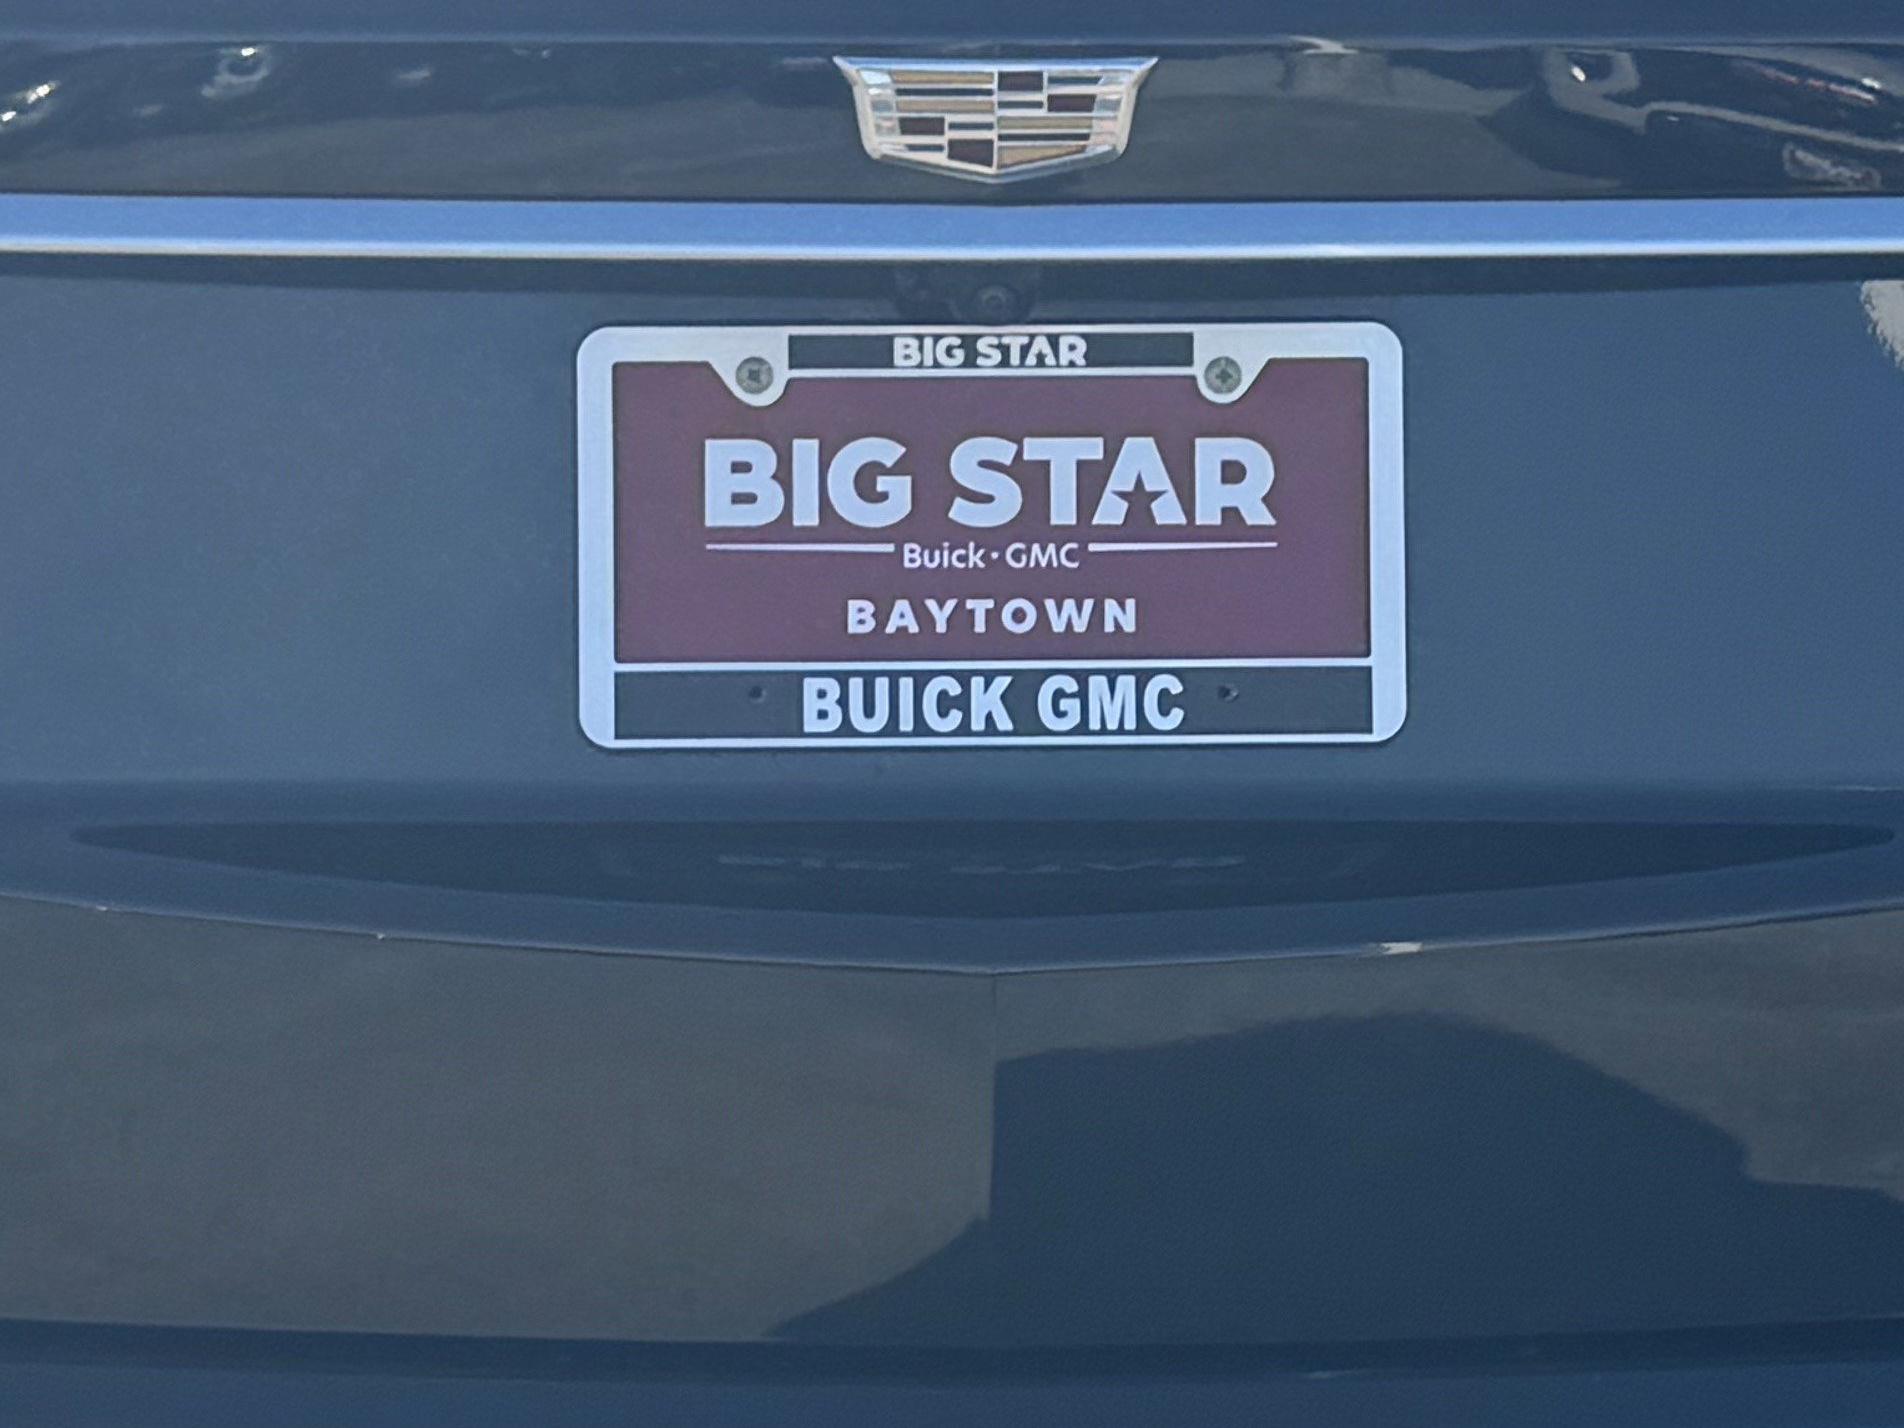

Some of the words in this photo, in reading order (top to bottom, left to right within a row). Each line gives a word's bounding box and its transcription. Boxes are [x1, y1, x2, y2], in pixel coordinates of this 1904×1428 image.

[893, 336, 964, 368] BIG
[976, 335, 1087, 368] STAR
[704, 436, 912, 528] BIG
[947, 436, 1277, 528] STAR
[846, 597, 1137, 635] BAYTOWN
[802, 675, 1014, 734] BUICK
[1037, 674, 1185, 733] GMC
